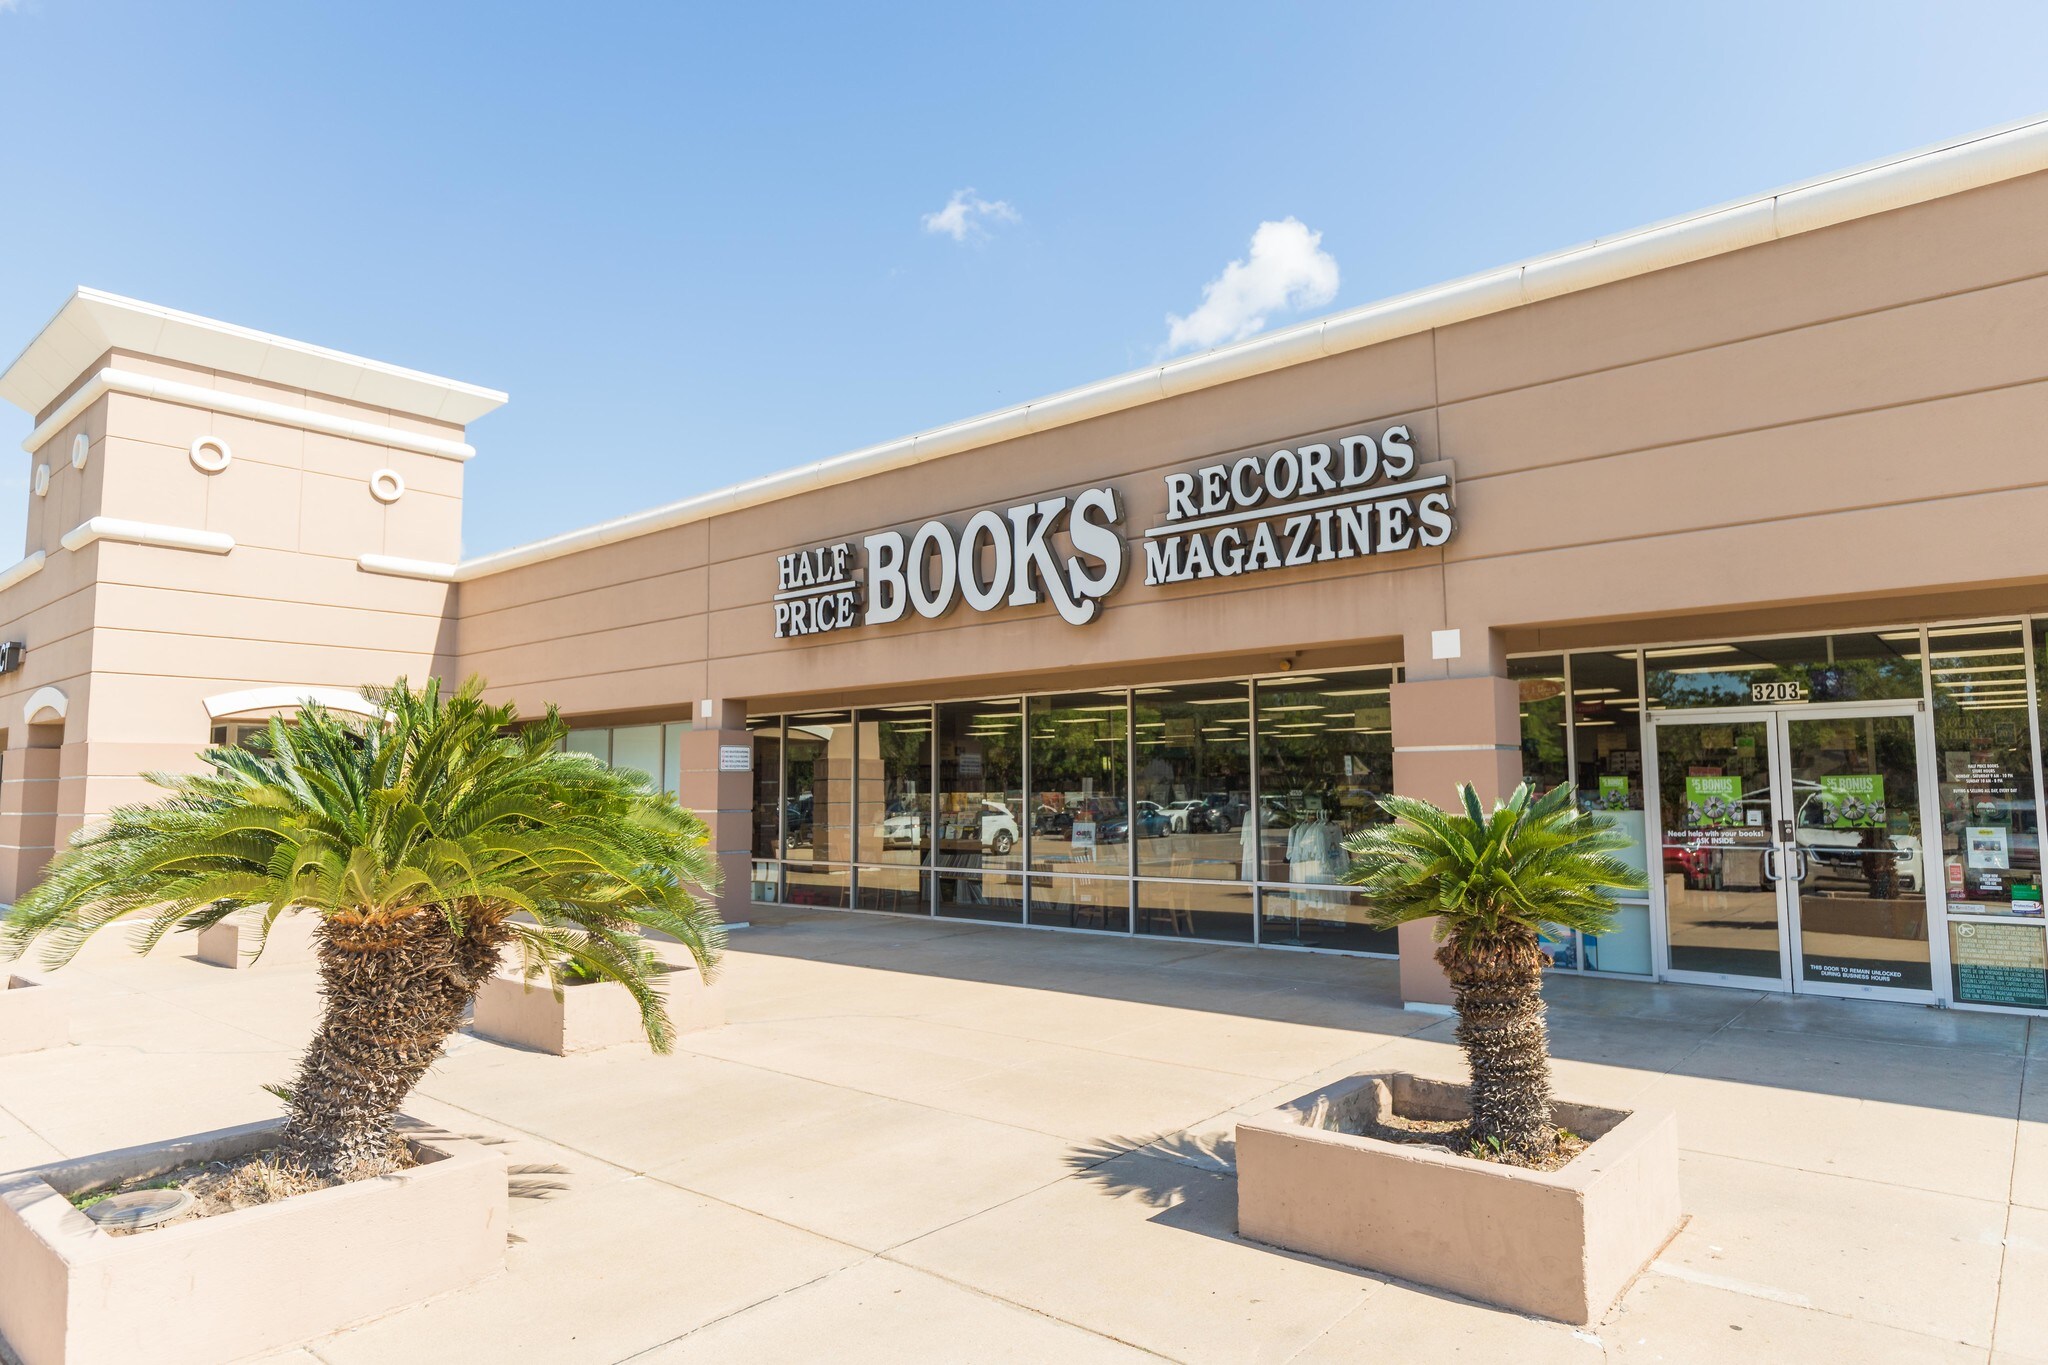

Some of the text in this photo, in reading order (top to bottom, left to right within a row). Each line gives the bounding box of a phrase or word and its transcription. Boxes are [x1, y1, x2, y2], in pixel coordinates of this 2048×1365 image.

[1165, 424, 1418, 522] RECORDS
[1143, 491, 1457, 587] MAGAZINES
[863, 487, 1128, 627] BOOKS
[777, 543, 856, 592] HALF
[774, 590, 861, 639] PRICE
[1754, 683, 1798, 700] 3203
[1691, 778, 1733, 791] $5 BONUS
[1827, 778, 1873, 791] $5 BONUS
[1688, 830, 1704, 838] help
[1711, 837, 1735, 845] INSIDE.
[1820, 970, 1841, 978] DURING
[1842, 972, 1870, 980] BUSINESS
[1849, 967, 1870, 975] REMAIN
[1871, 969, 1902, 978] UNLOCKED
